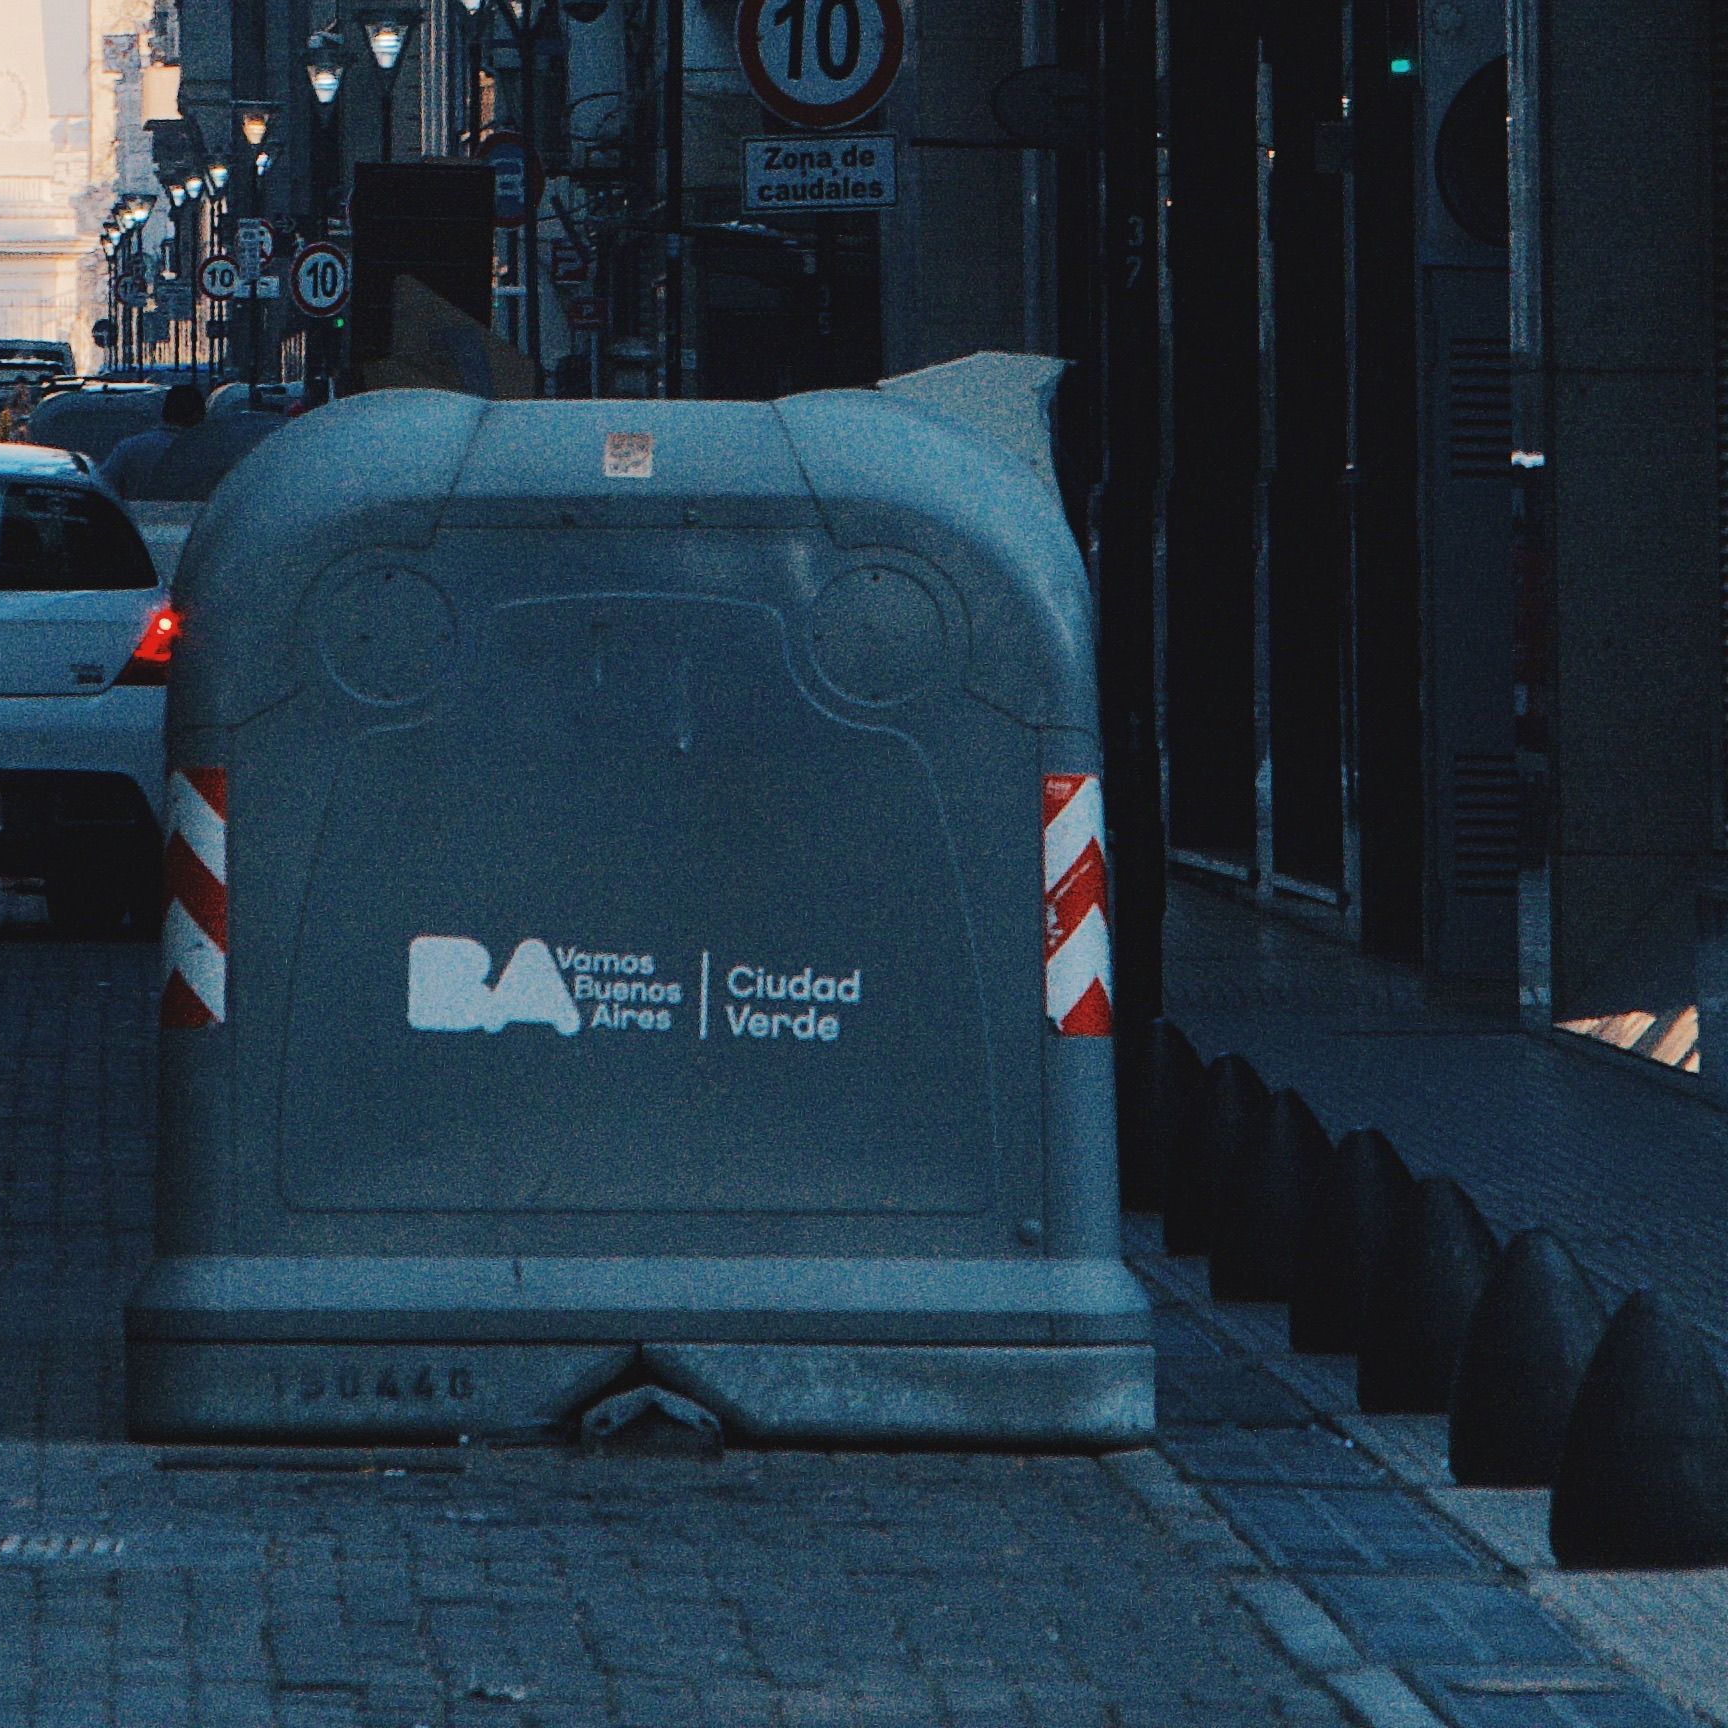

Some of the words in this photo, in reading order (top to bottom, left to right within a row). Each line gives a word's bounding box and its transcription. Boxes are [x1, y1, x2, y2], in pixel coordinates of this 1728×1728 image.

[764, 146, 833, 171] Zona
[841, 144, 875, 167] de
[757, 176, 885, 201] caudales
[207, 268, 235, 288] 10
[306, 261, 338, 299] 10
[555, 946, 657, 975] Vamos
[574, 974, 683, 1005] Buenos
[726, 965, 863, 1005] Ciudad
[590, 1005, 673, 1031] Aires
[725, 1004, 841, 1042] Verde
